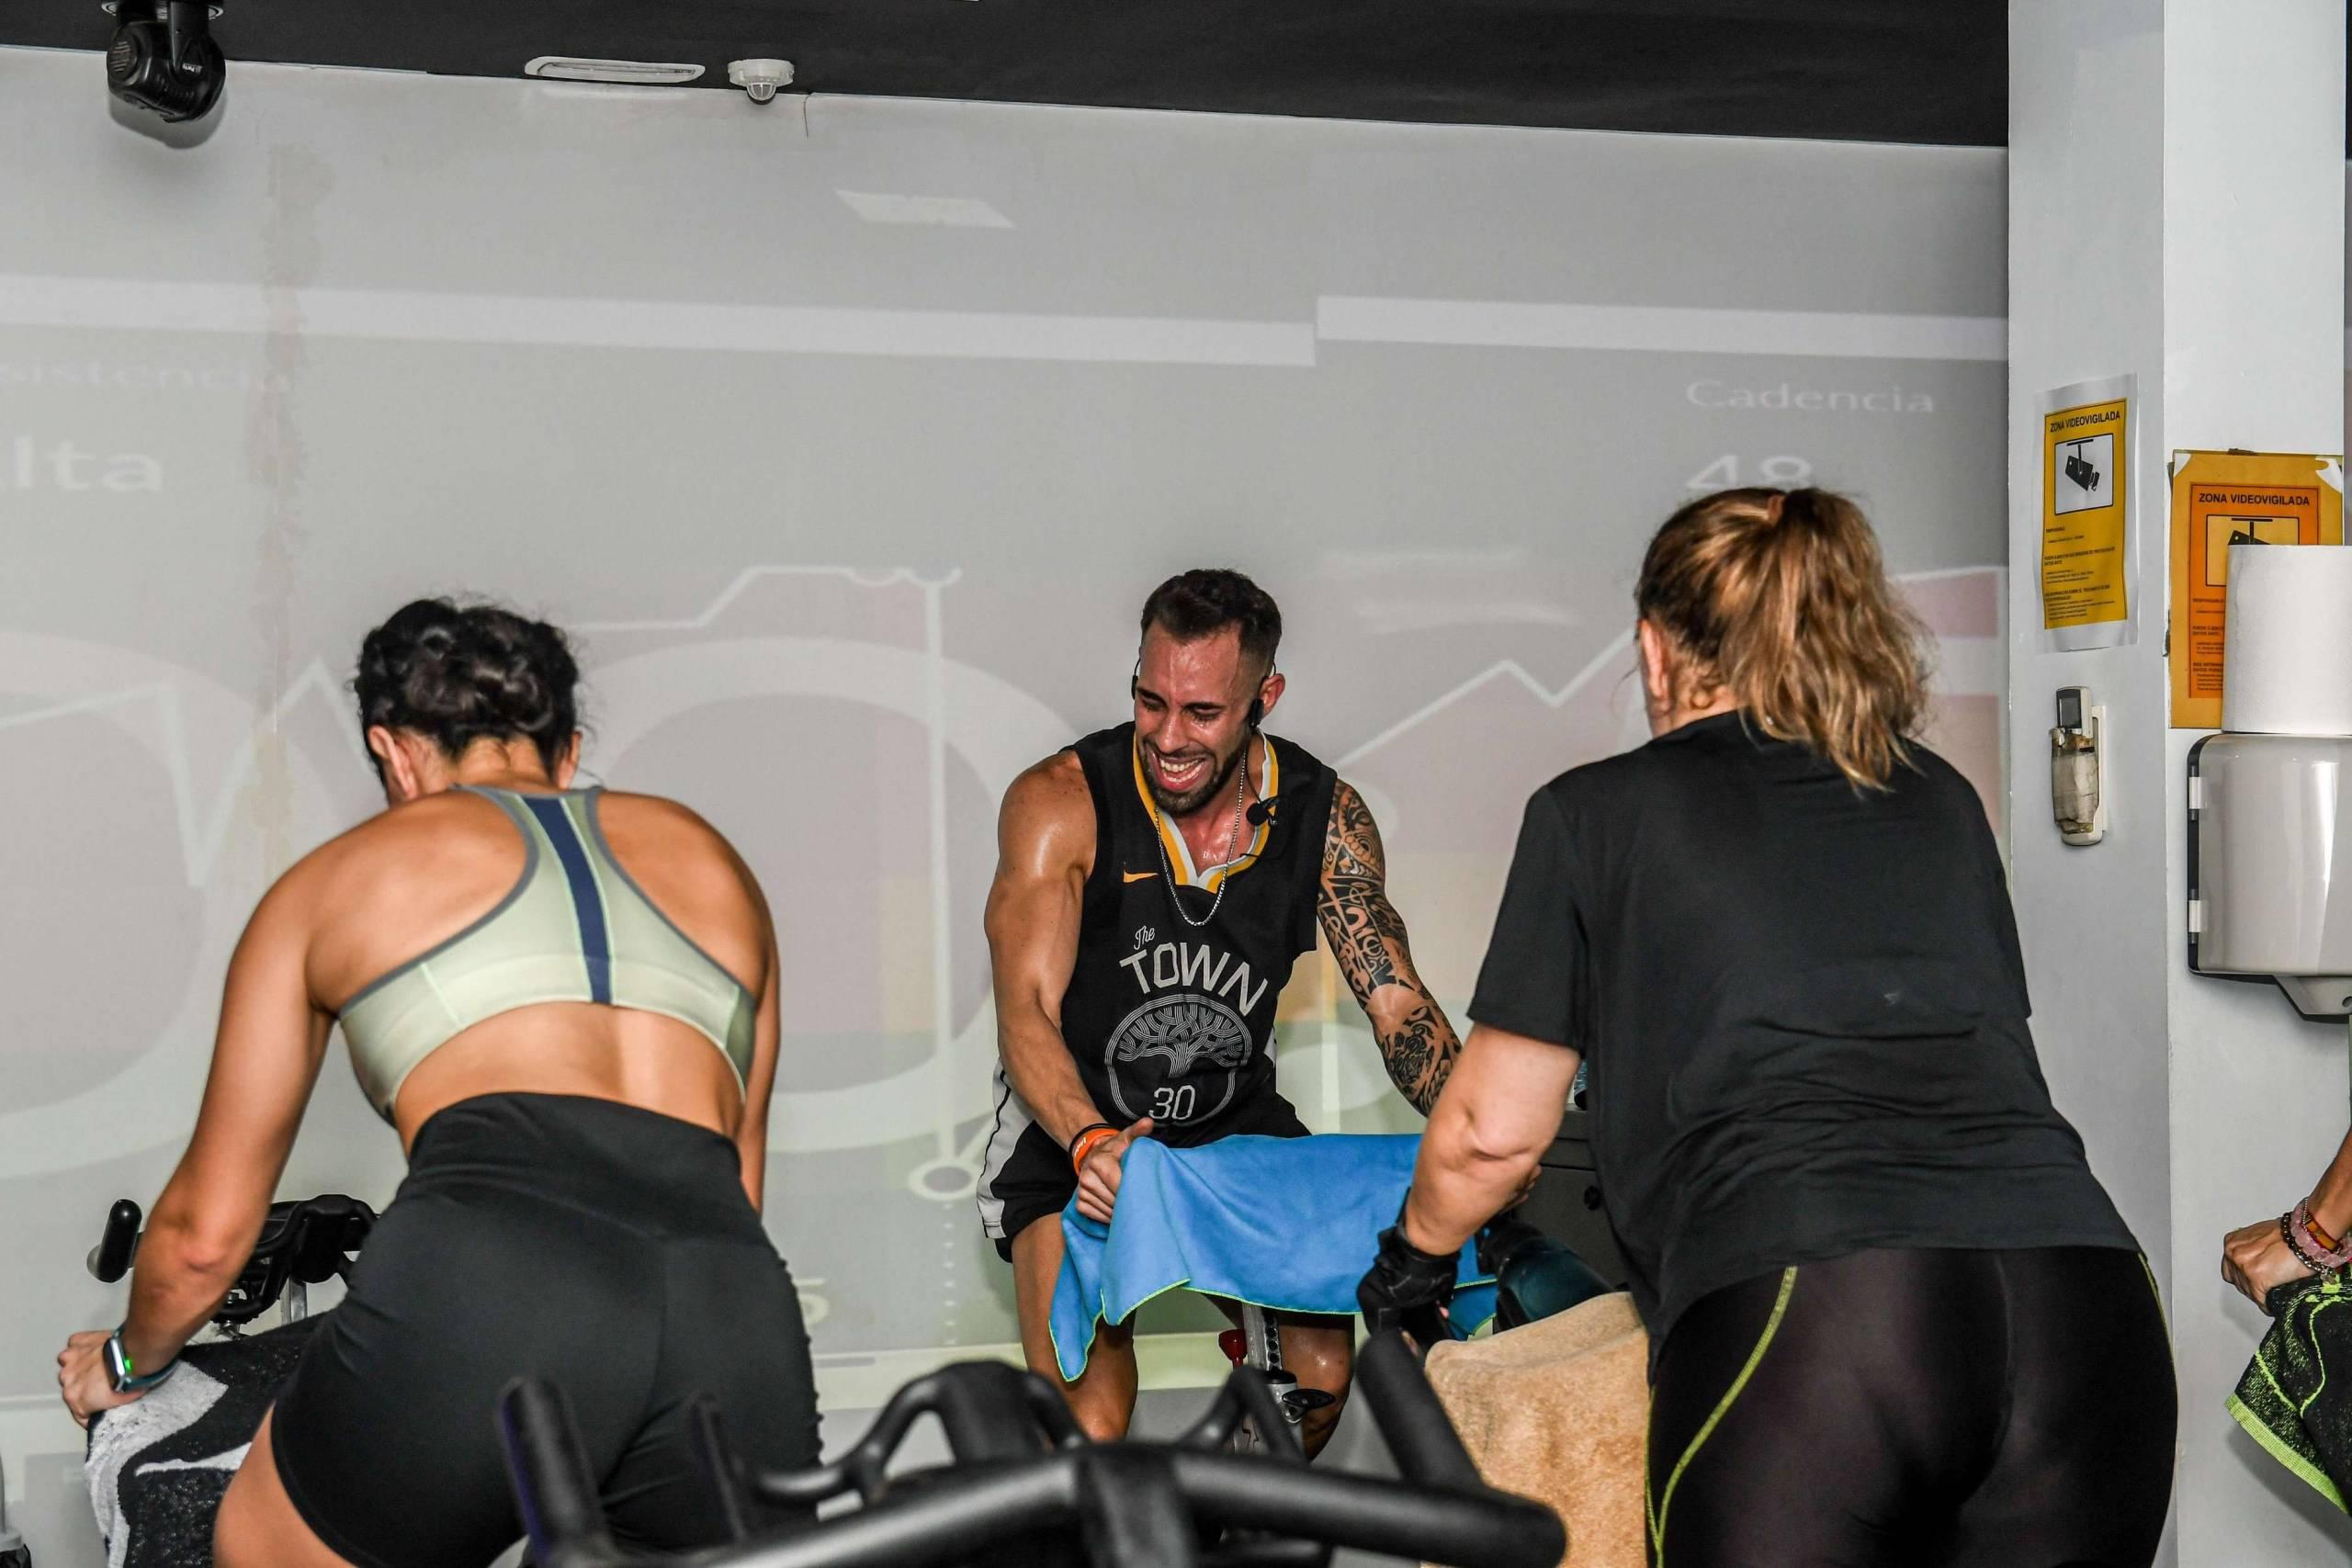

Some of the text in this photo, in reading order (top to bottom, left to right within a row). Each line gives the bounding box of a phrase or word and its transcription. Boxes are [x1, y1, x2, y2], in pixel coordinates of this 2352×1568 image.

[1685, 379, 1934, 412] Cadencia
[2050, 410, 2120, 433] ZONA VIDEOVIGILADA
[0, 434, 163, 492] lta
[2199, 492, 2310, 506] ZONA VIDEOVIGILADA
[1133, 925, 1156, 950] The
[1119, 942, 1268, 1016] TOWN
[1148, 1085, 1196, 1120] 30
